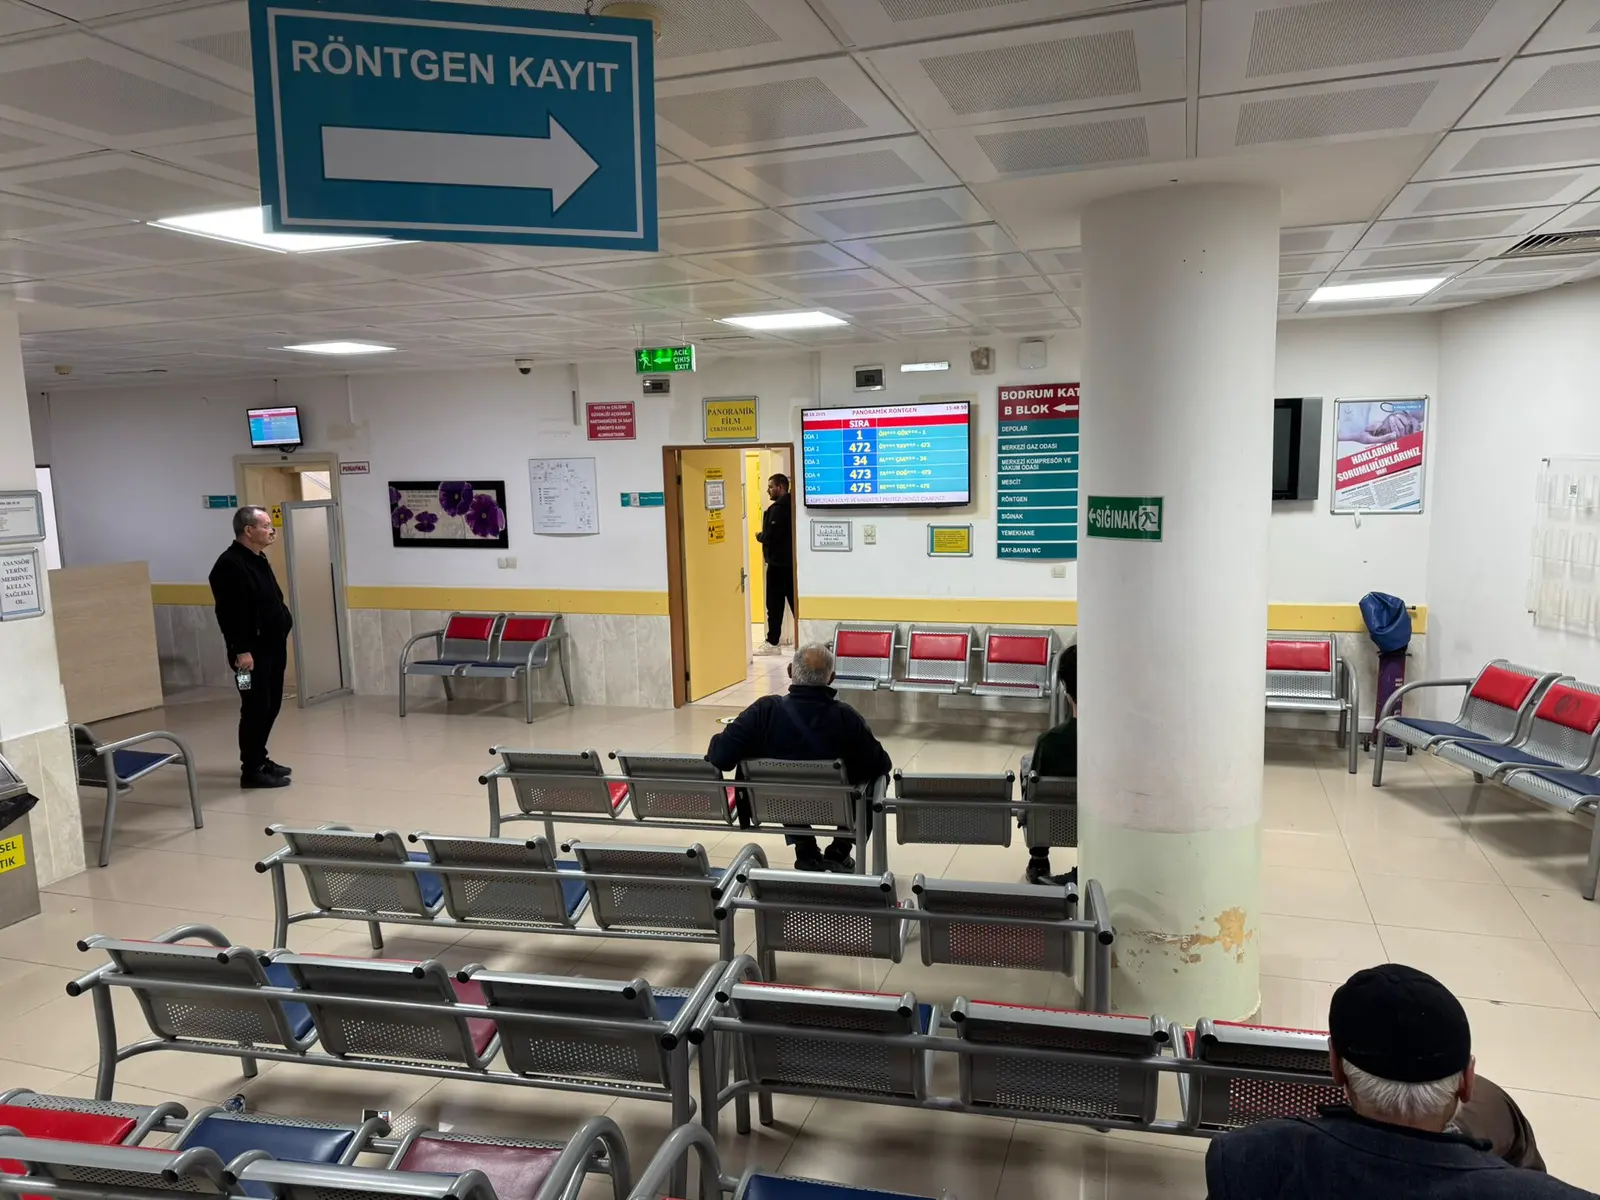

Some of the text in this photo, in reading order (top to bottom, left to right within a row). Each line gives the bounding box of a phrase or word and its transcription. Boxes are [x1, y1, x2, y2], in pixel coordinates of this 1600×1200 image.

[292, 36, 619, 92] RÖNTGEN KAYIT
[1001, 387, 1080, 400] BODRUM KAT
[707, 406, 755, 416] PANORAMİK
[852, 408, 888, 416] PANORAMİK
[1004, 404, 1050, 415] B BLOK
[721, 416, 741, 425] FİLM
[849, 420, 870, 428] SIRA
[856, 430, 863, 440] 1
[849, 442, 871, 453] 472
[1351, 442, 1399, 465] HAKLARINIZ
[852, 455, 868, 466] 34
[1337, 447, 1421, 482] SORUMLULUKLARINIZ
[849, 469, 871, 479] 473
[850, 483, 872, 493] 475
[1096, 505, 1138, 530] SIĞINAK
[2, 558, 30, 567] ASANSÖR
[6, 567, 29, 575] YERİNE
[1, 574, 33, 583] MERDİVEN
[6, 582, 31, 590] KULLAN
[5, 589, 34, 598] SAĞLIKLI
